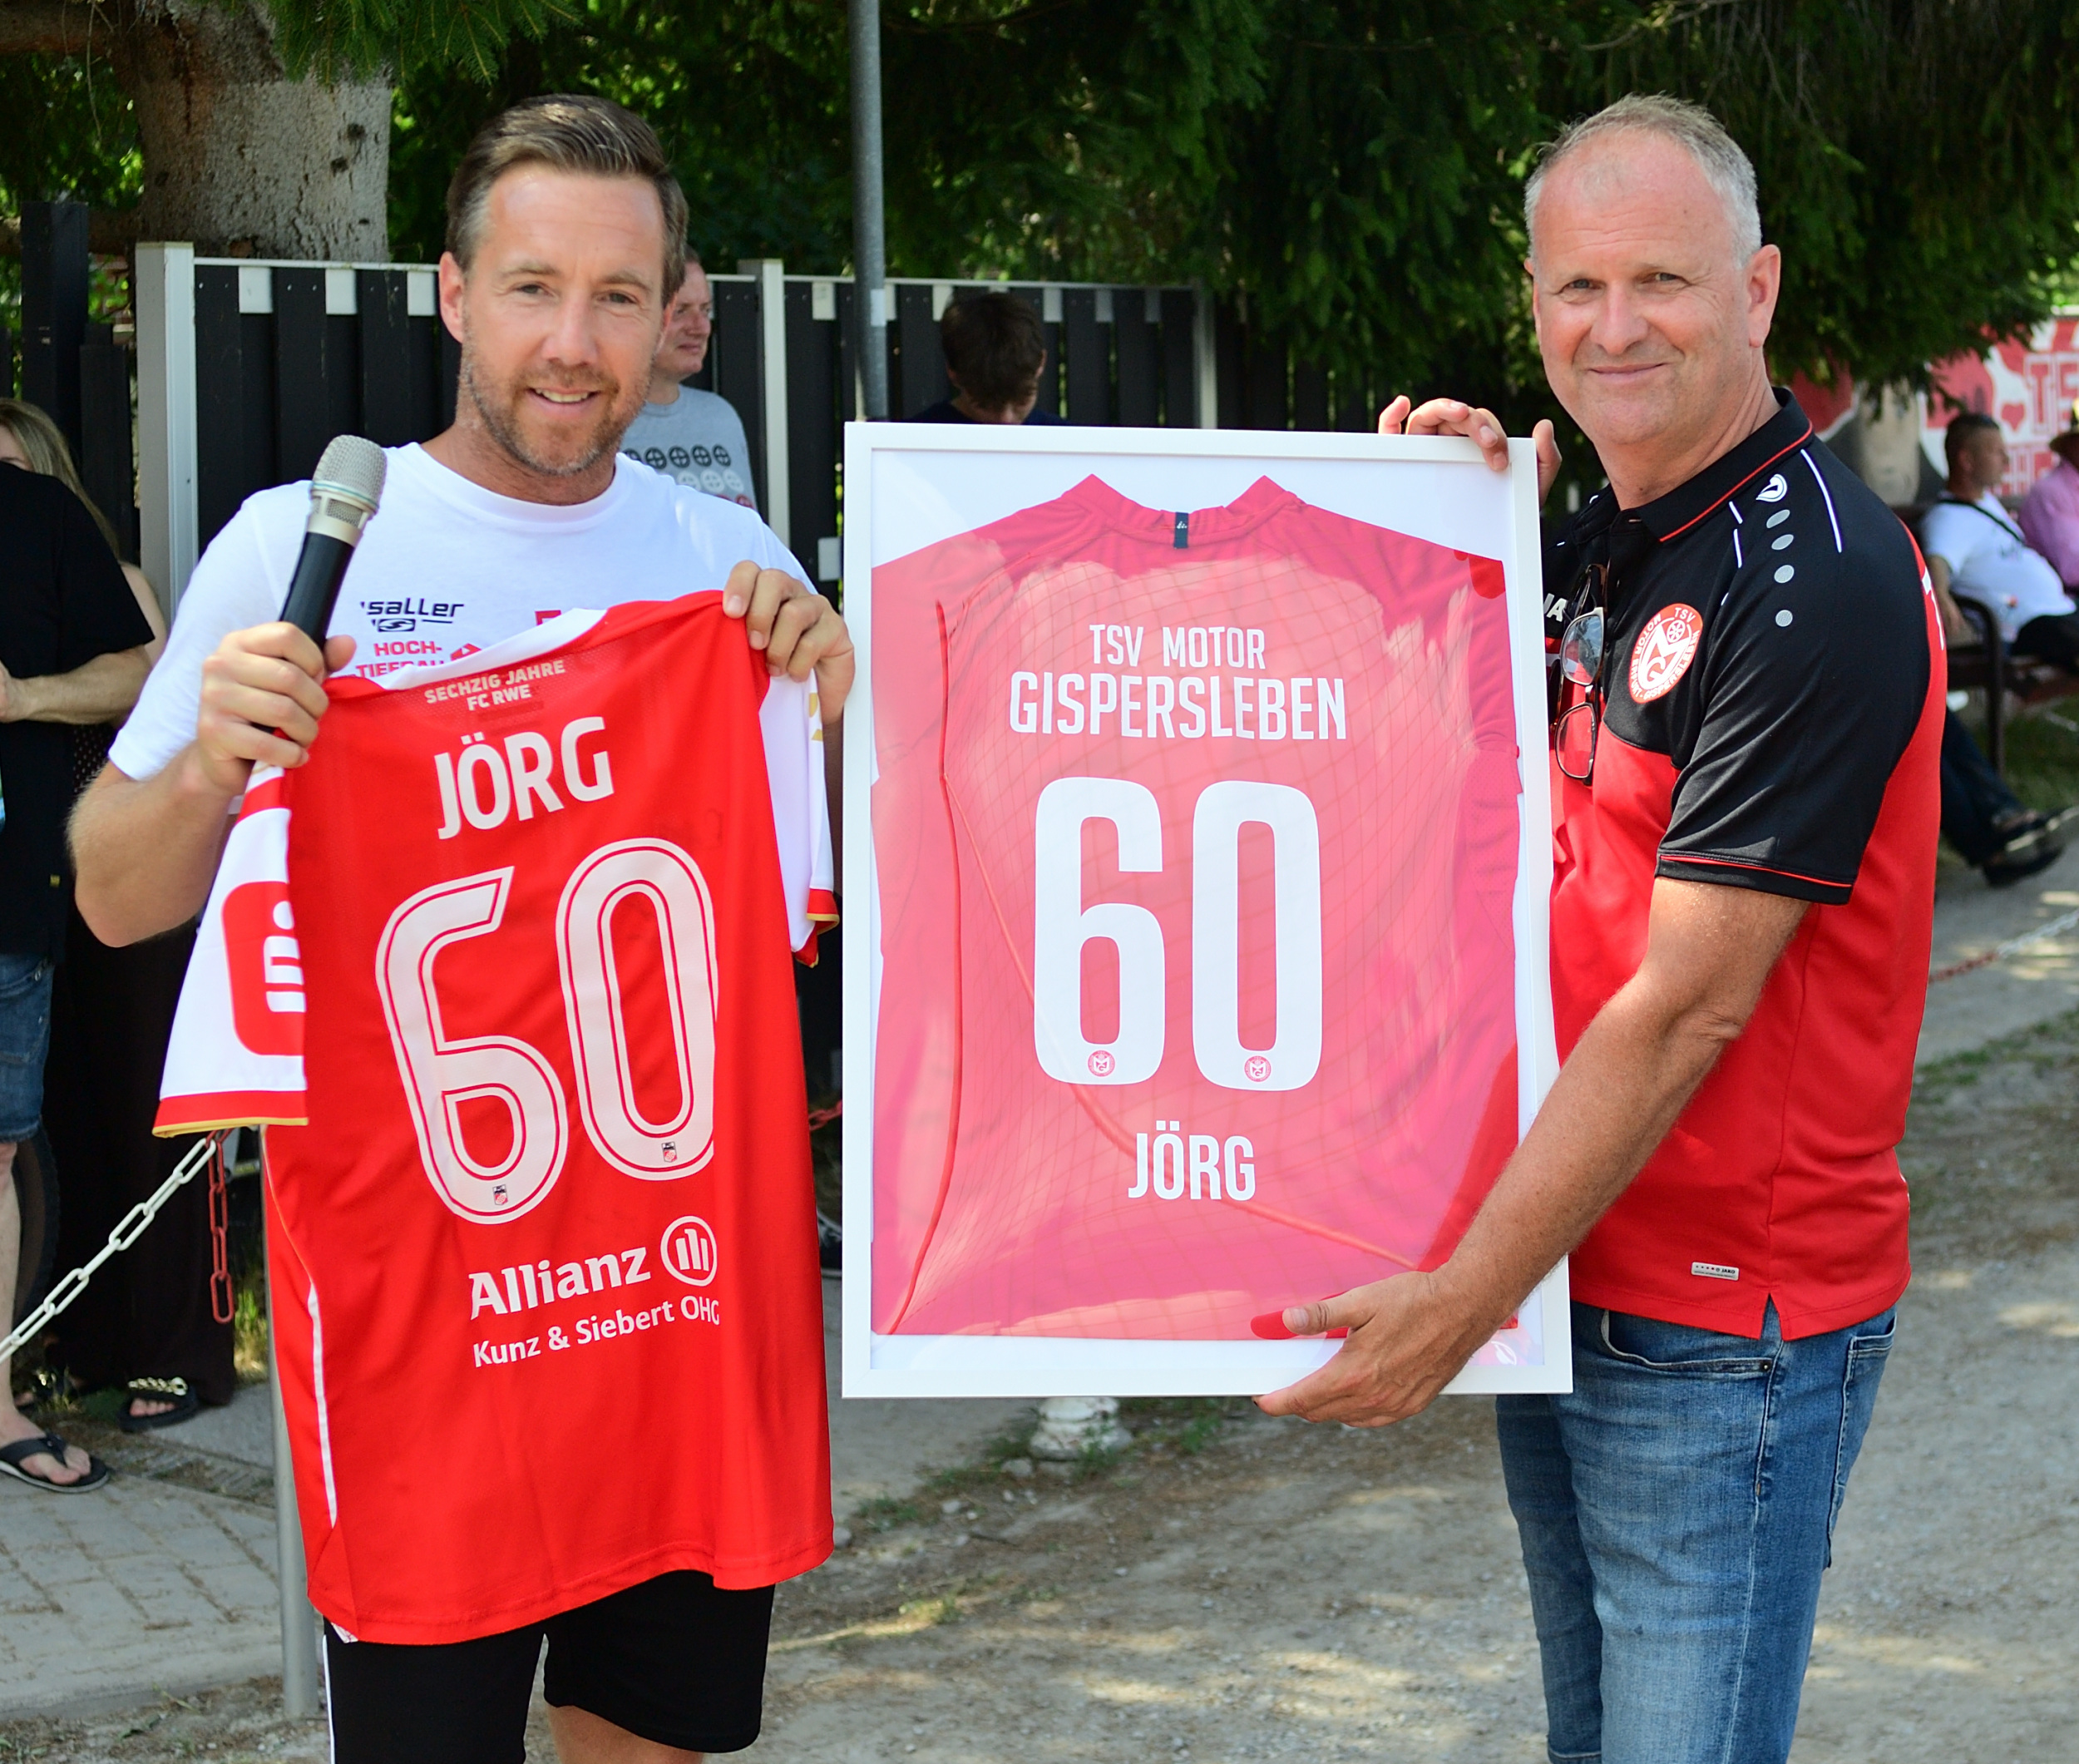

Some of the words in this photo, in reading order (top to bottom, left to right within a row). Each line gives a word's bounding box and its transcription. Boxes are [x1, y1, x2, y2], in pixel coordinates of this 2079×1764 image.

[1635, 614, 1662, 655] MOTOR
[1674, 607, 1696, 623] TSV
[356, 660, 444, 678] TIEF
[374, 640, 442, 657] HOCH-
[1089, 624, 1144, 667] TSV
[1163, 626, 1266, 670] MOTOR
[424, 674, 501, 704] SECHZIG
[506, 660, 565, 685] JAHRE
[467, 692, 490, 711] FC
[492, 684, 531, 705] RWE
[1010, 671, 1346, 740] GISPERSLEBEN
[434, 716, 615, 840] JÖRG
[1034, 776, 1322, 1091] 60
[375, 838, 719, 1224] 60
[1128, 1120, 1257, 1201] JÖRG
[468, 1247, 651, 1321] Allianz
[473, 1337, 541, 1368] Kunz
[547, 1326, 571, 1351] &
[575, 1300, 675, 1345] Siebert
